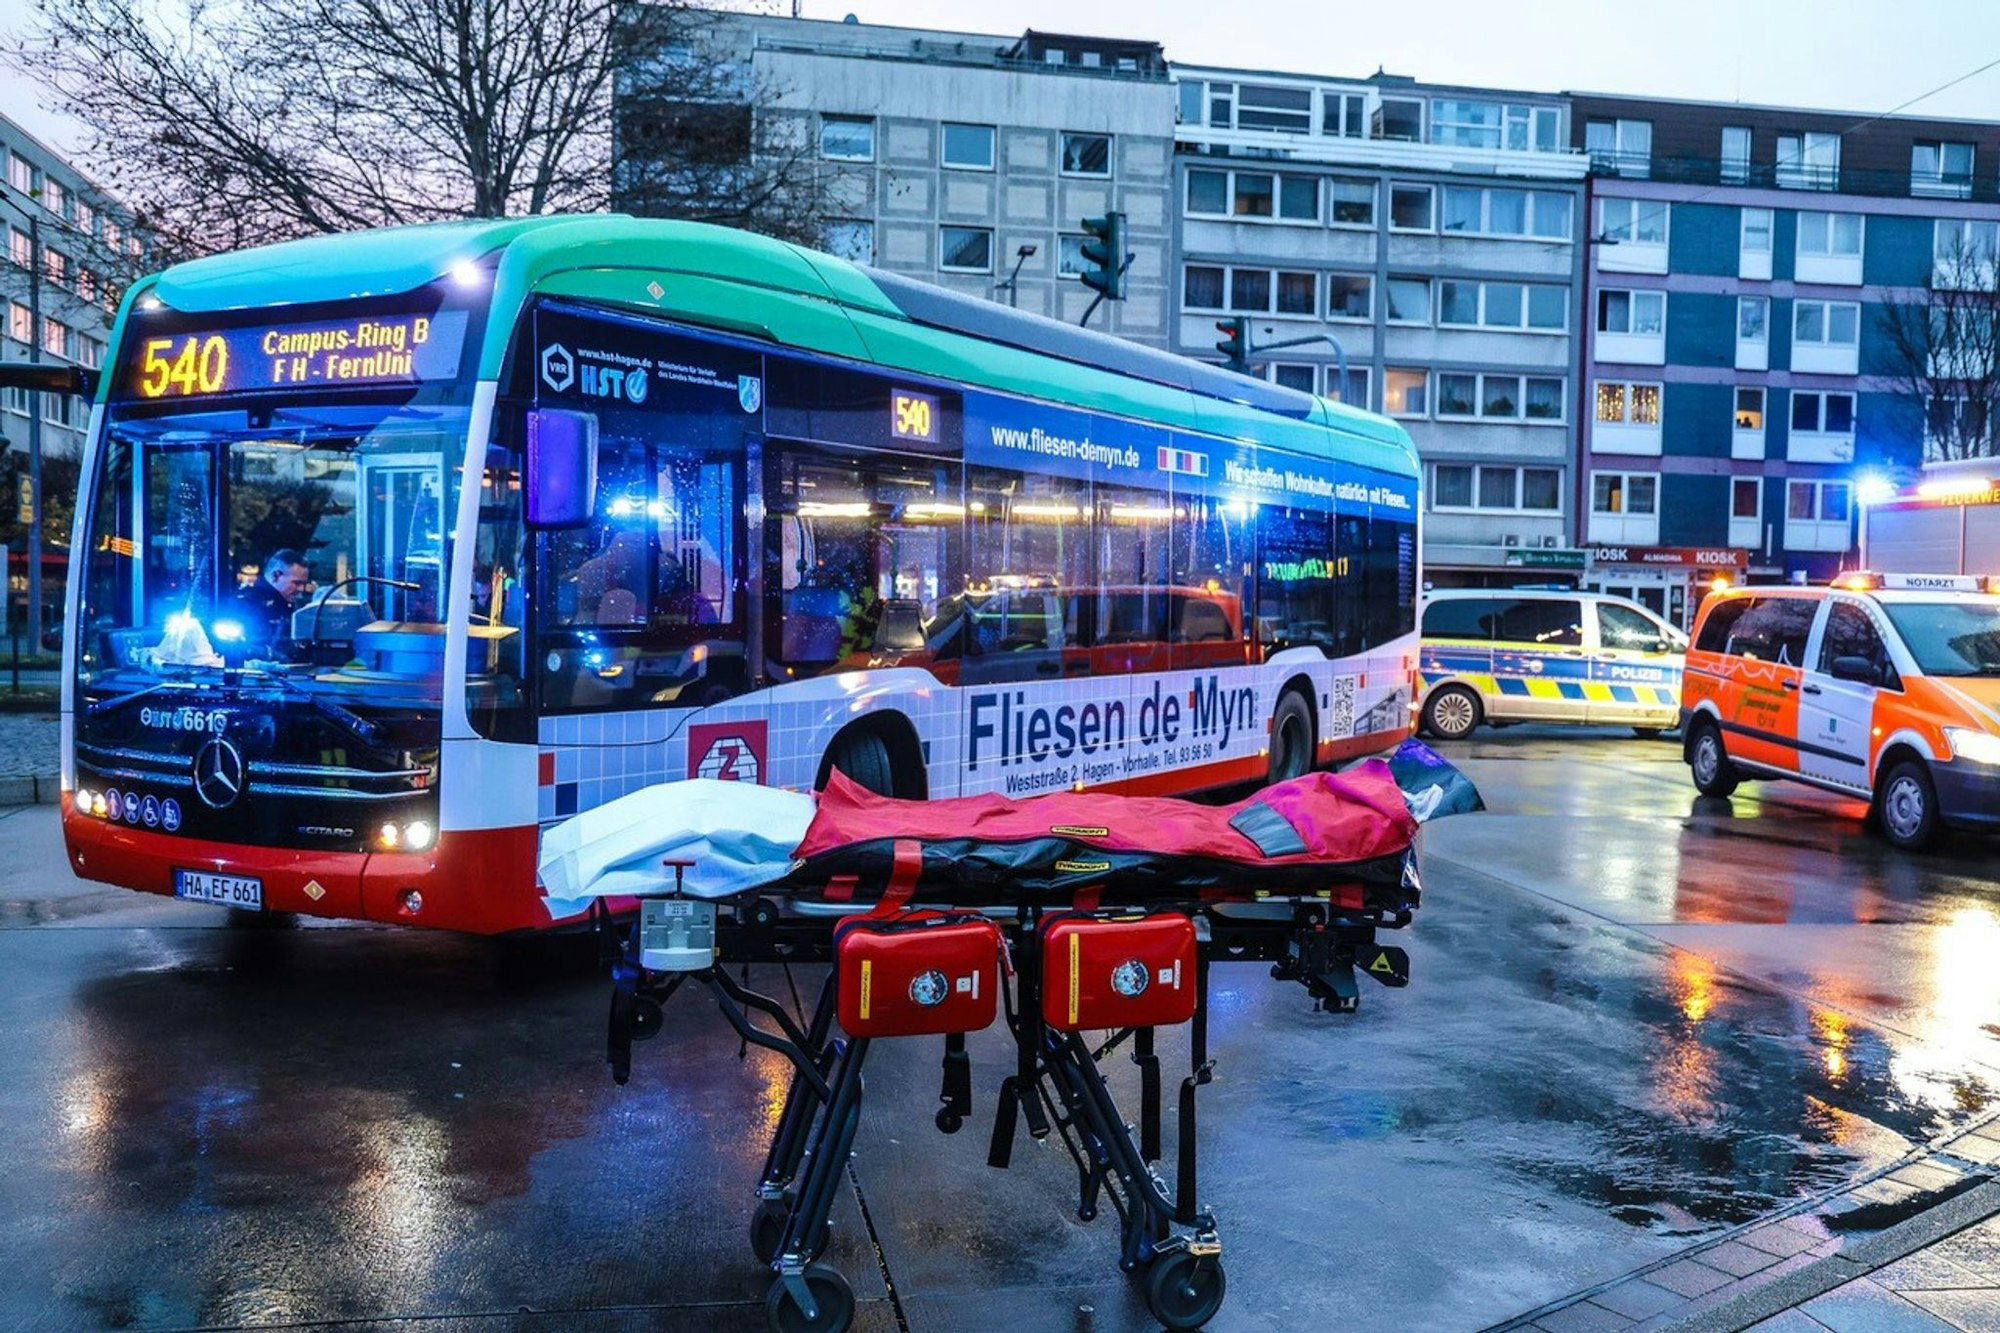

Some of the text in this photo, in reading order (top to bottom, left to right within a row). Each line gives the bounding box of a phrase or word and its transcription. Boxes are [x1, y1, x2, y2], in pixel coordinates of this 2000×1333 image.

[263, 317, 429, 357] Campus-Ring B
[142, 335, 228, 397] 540
[327, 350, 412, 380] FernUni
[549, 361, 567, 374] VRR
[577, 348, 653, 368] www.hst-hagen.de
[581, 364, 625, 399] HST
[896, 396, 930, 436] 540
[991, 426, 1140, 470] www.fliesen-demyn.de
[1696, 551, 1737, 564] KIOSK
[1906, 578, 1955, 588] NOTARZT
[1611, 666, 1662, 681] POLIZEI
[968, 690, 1125, 772] Fliesen
[1138, 680, 1180, 746] de
[1192, 675, 1253, 750] Myn
[1005, 764, 1069, 794] Weststraße
[1082, 759, 1114, 782] Hagen
[1179, 746, 1190, 763] 93
[184, 874, 260, 904] HA EF 661
